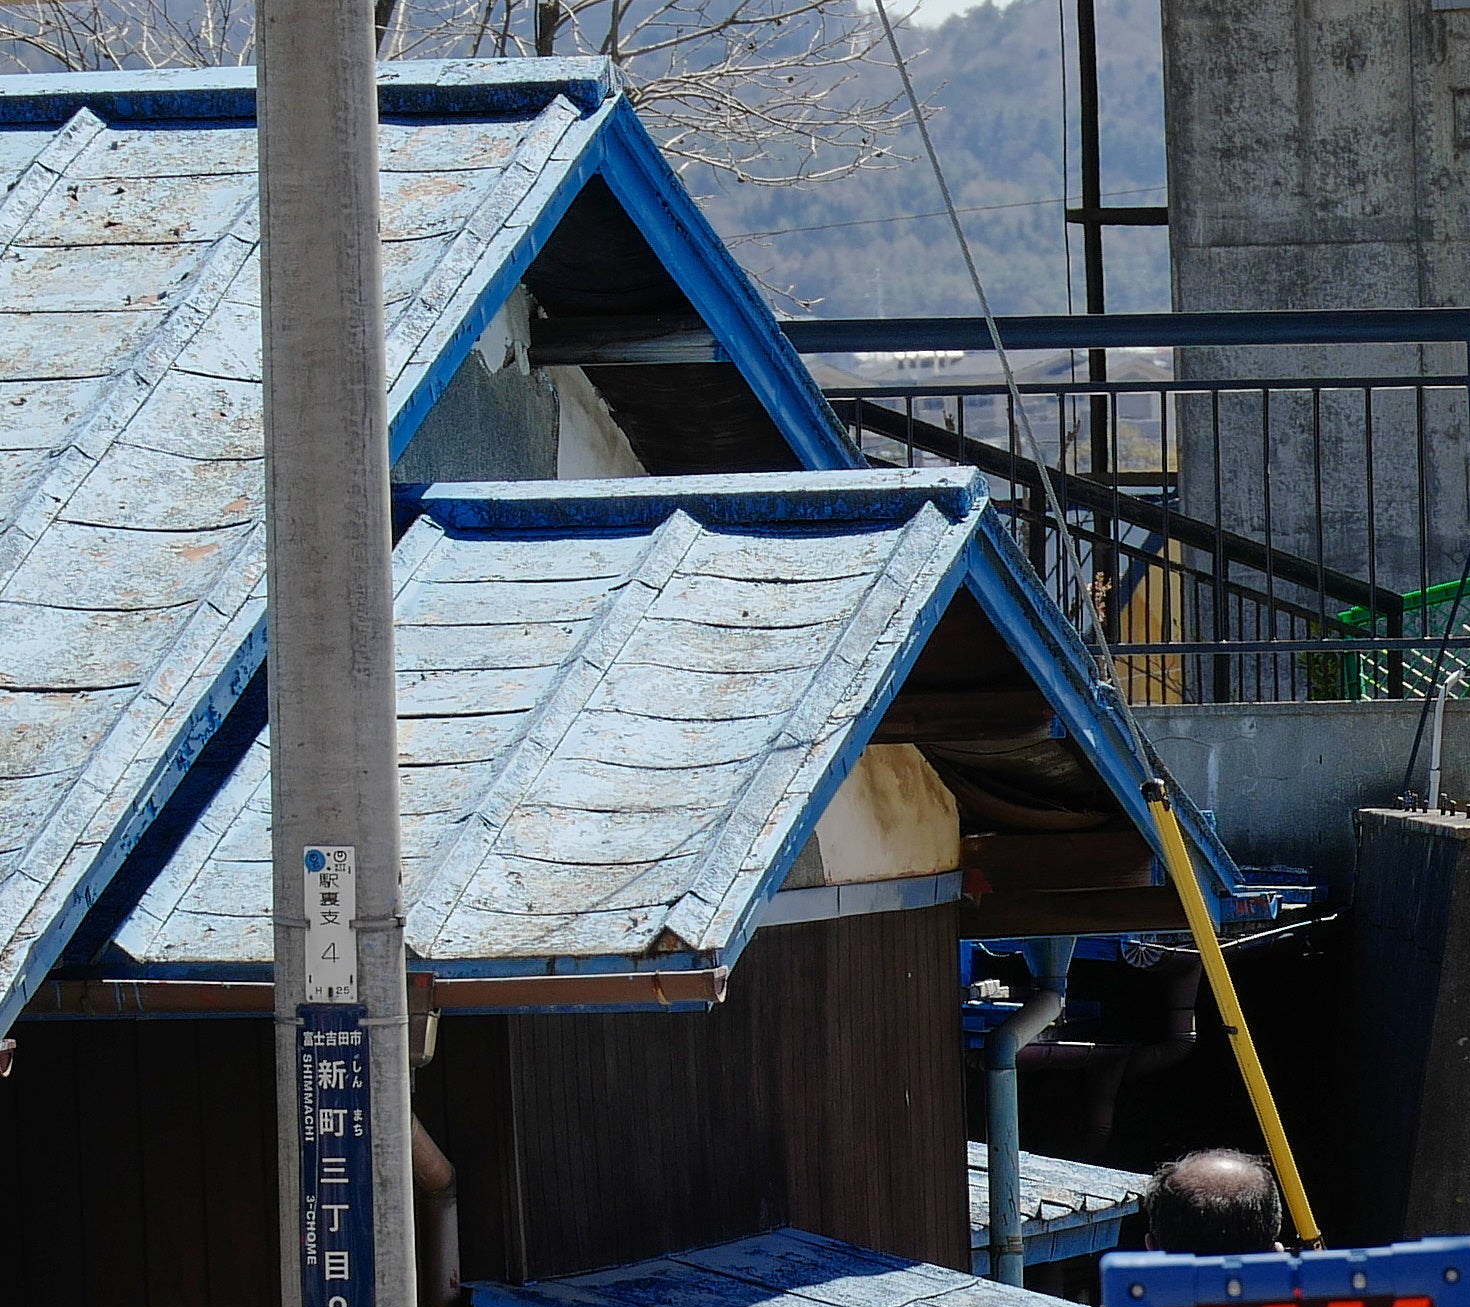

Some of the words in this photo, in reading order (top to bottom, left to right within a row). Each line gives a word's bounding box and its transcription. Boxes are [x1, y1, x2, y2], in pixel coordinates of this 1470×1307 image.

[320, 942, 341, 964] 4
[303, 1031, 362, 1047] 富士吉田市
[303, 1053, 315, 1142] SHIMMACHI
[305, 1194, 318, 1266] 3-CHOME
